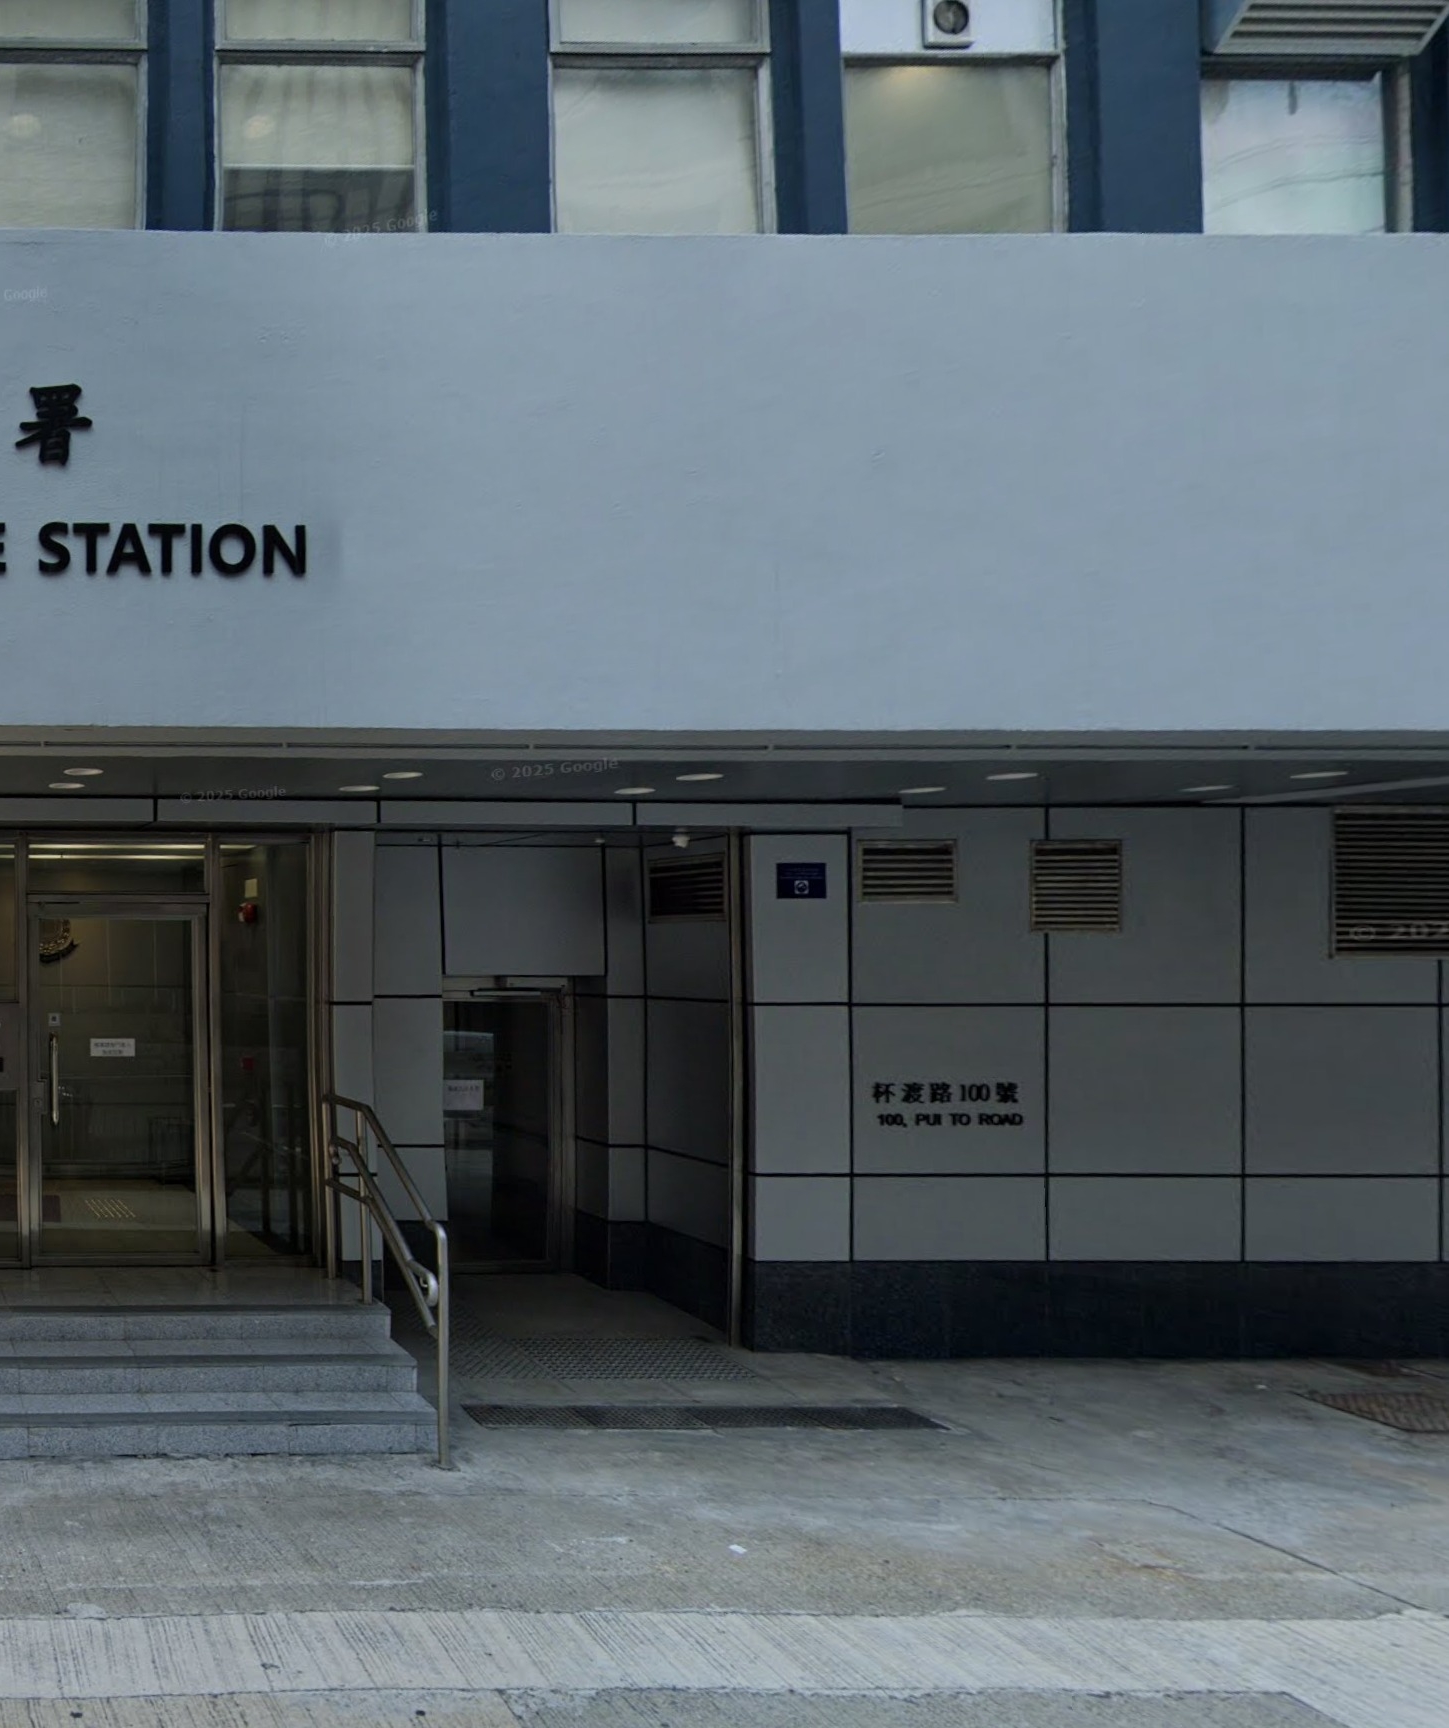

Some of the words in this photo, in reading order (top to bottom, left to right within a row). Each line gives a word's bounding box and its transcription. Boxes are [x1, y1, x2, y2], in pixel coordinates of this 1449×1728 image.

[39, 522, 307, 578] STATION
[877, 1113, 907, 1128] 100,
[914, 1113, 942, 1127] PUI
[949, 1113, 972, 1127] TO
[978, 1113, 1024, 1127] ROAD
